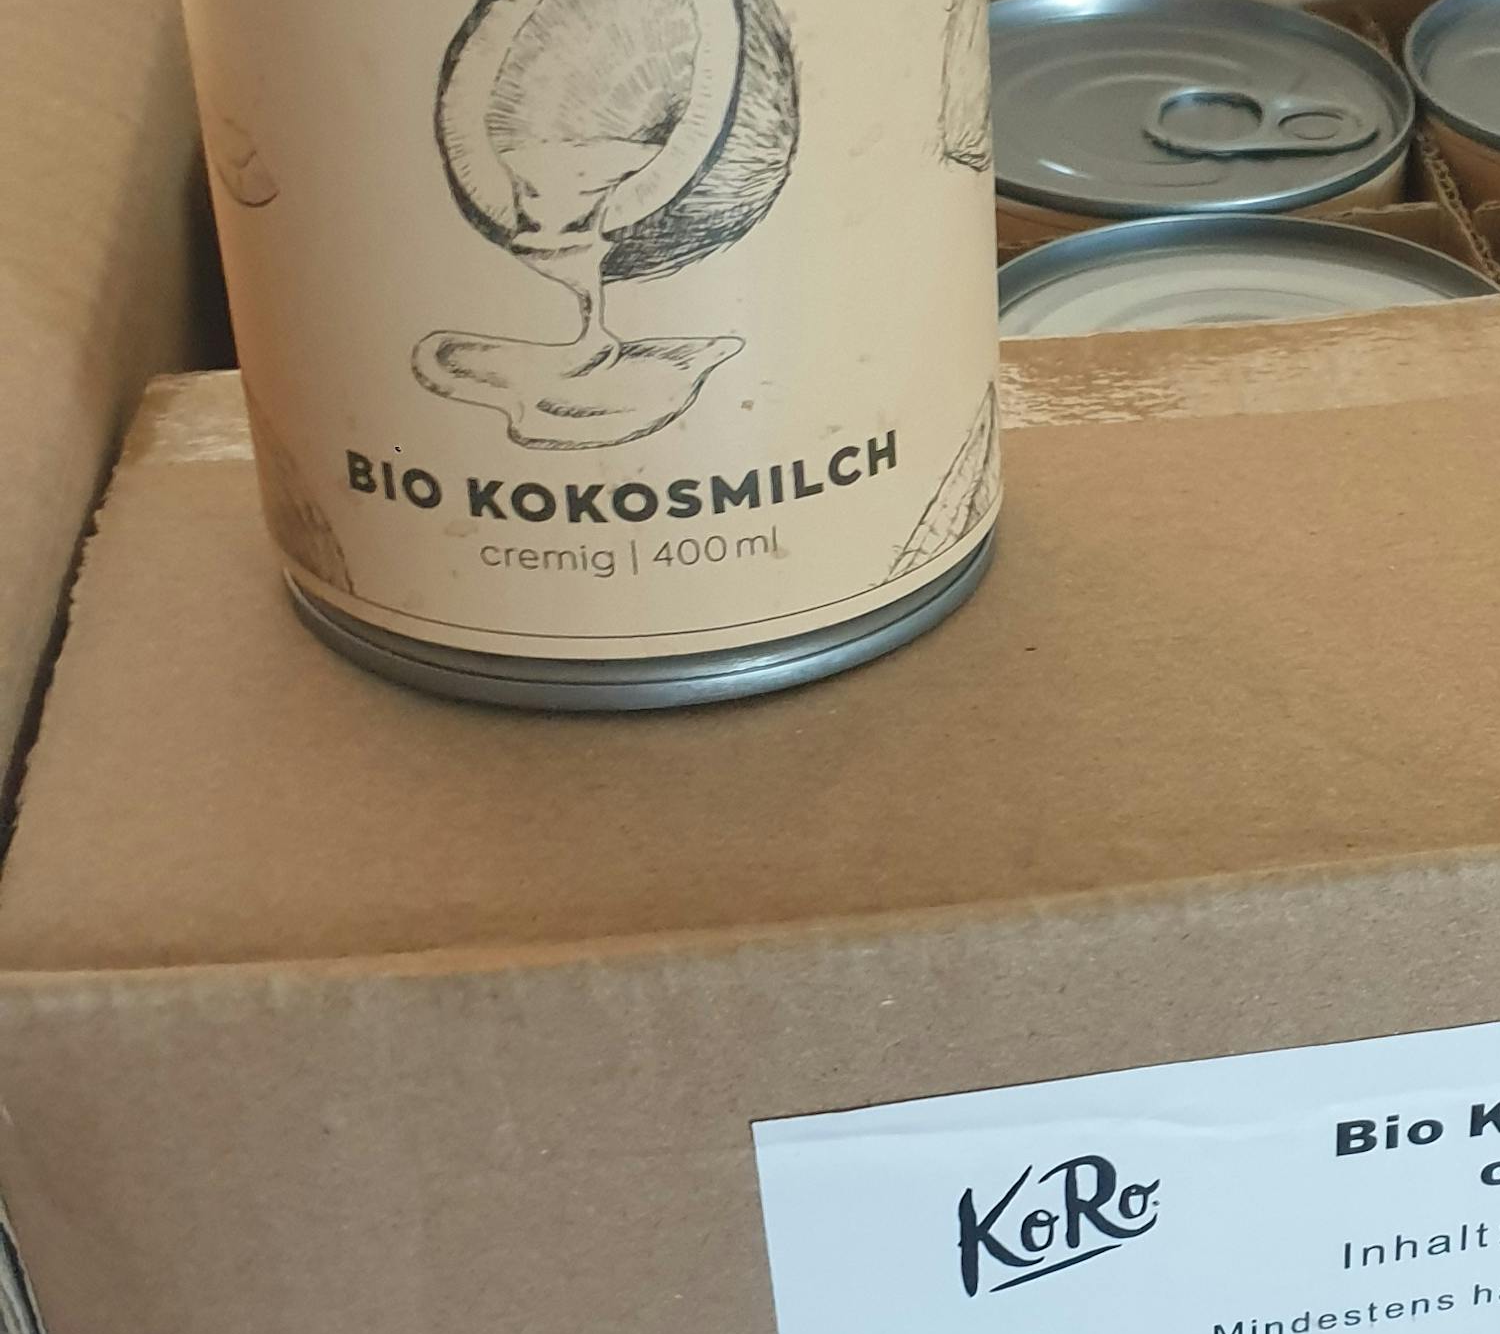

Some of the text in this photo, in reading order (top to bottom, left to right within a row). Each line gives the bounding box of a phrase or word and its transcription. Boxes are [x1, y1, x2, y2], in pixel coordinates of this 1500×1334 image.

[345, 429, 897, 523] BIO KOKOSMILCH
[480, 542, 614, 577] cremig
[1335, 1115, 1444, 1157] Bio
[958, 1155, 1160, 1297] KoRo
